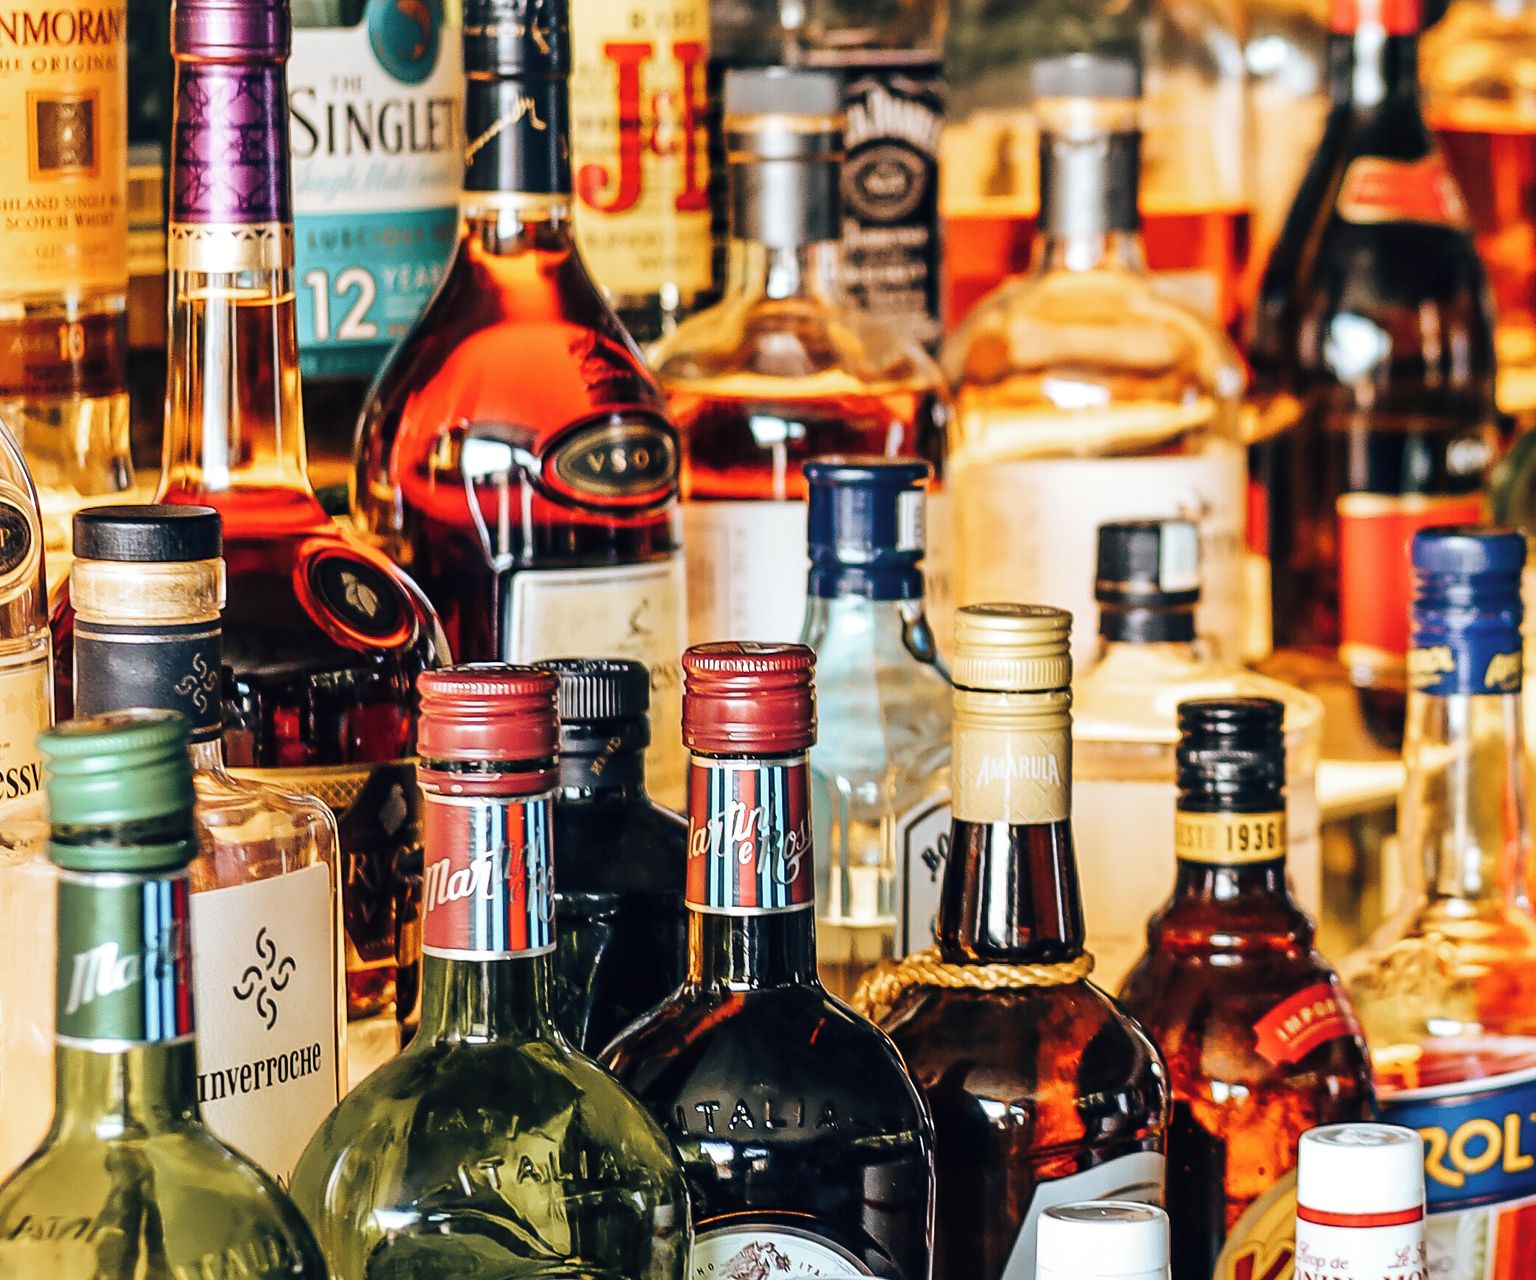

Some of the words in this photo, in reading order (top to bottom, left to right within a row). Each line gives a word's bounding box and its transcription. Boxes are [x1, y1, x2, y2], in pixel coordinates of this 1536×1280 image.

[304, 267, 377, 342] 12
[975, 754, 1061, 789] AMARULA
[1225, 821, 1276, 852] 1936
[1329, 1255, 1349, 1270] de
